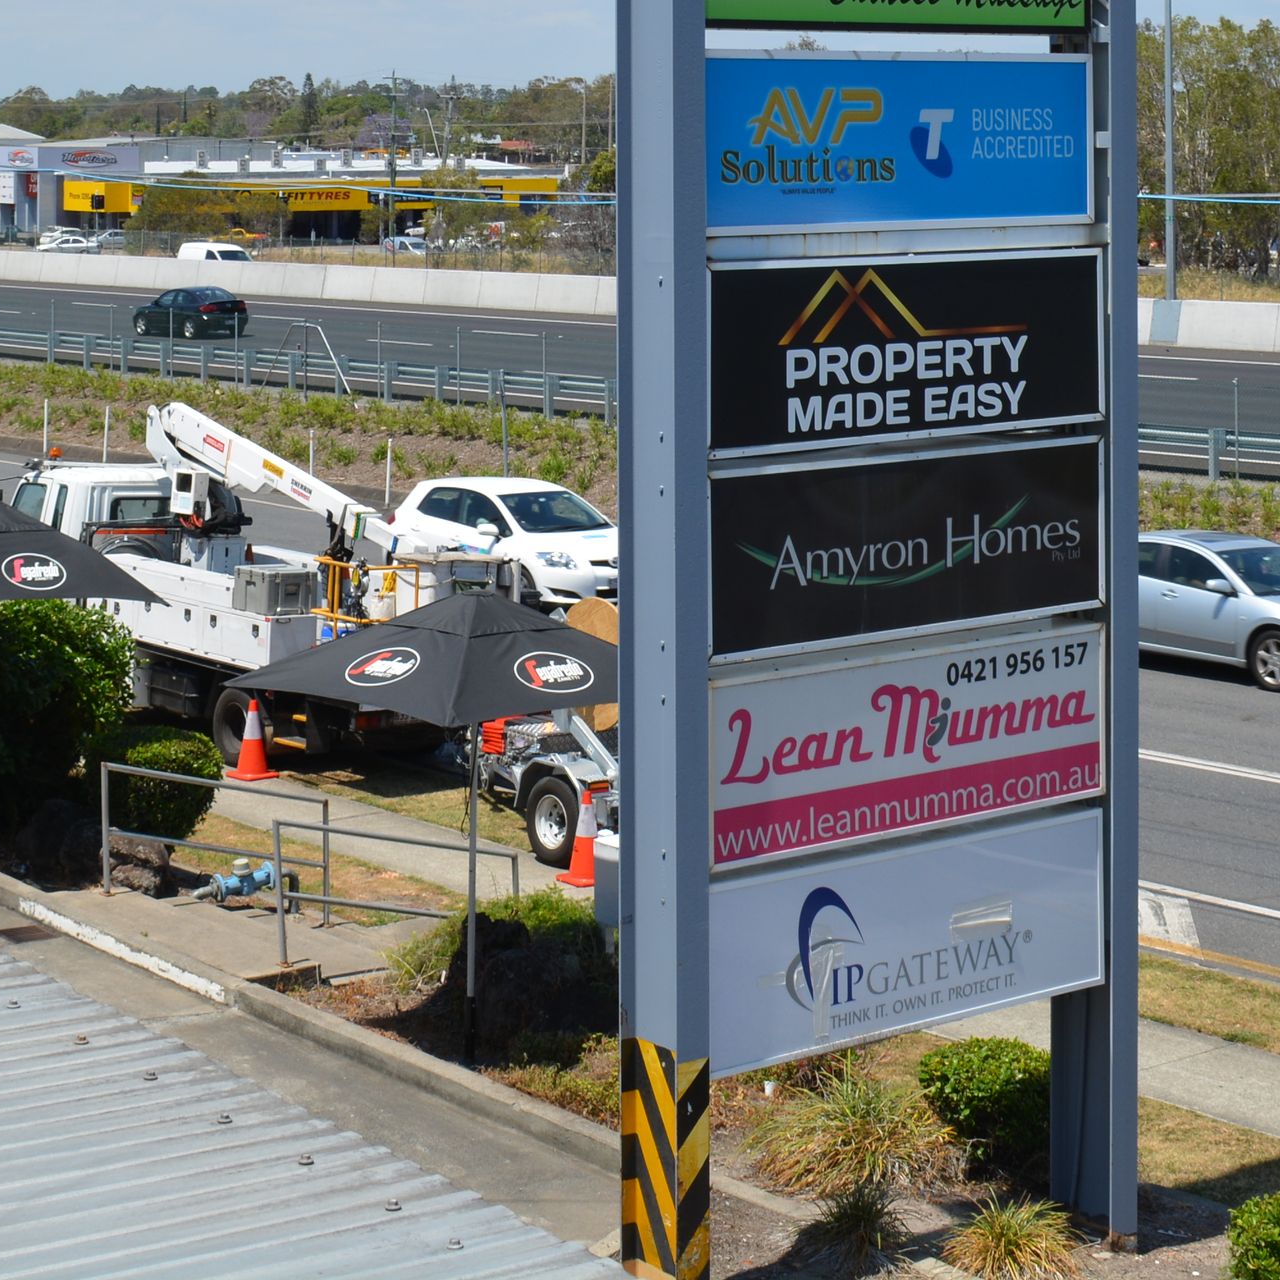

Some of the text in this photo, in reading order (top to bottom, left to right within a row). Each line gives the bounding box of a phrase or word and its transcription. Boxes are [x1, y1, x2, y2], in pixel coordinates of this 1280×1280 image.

[747, 88, 883, 146] AVP
[972, 108, 1054, 131] BUSINESS
[720, 144, 896, 184] Solutions
[972, 135, 1075, 160] ACCREDITED
[307, 191, 351, 201] TYRES
[785, 335, 1028, 389] PROPERTY
[787, 380, 1027, 434] MADE EASY
[770, 514, 1081, 590] Amyron Homes
[1067, 546, 1081, 560] Ltd
[525, 658, 584, 687] Segafredo
[946, 642, 1088, 686] 0421 956 157
[720, 684, 1096, 785] Lean Mumma
[717, 762, 1099, 857] www.leanmumma.com.au
[830, 972, 1017, 1029] THINK IT. OWN IT. PROTECT IT.
